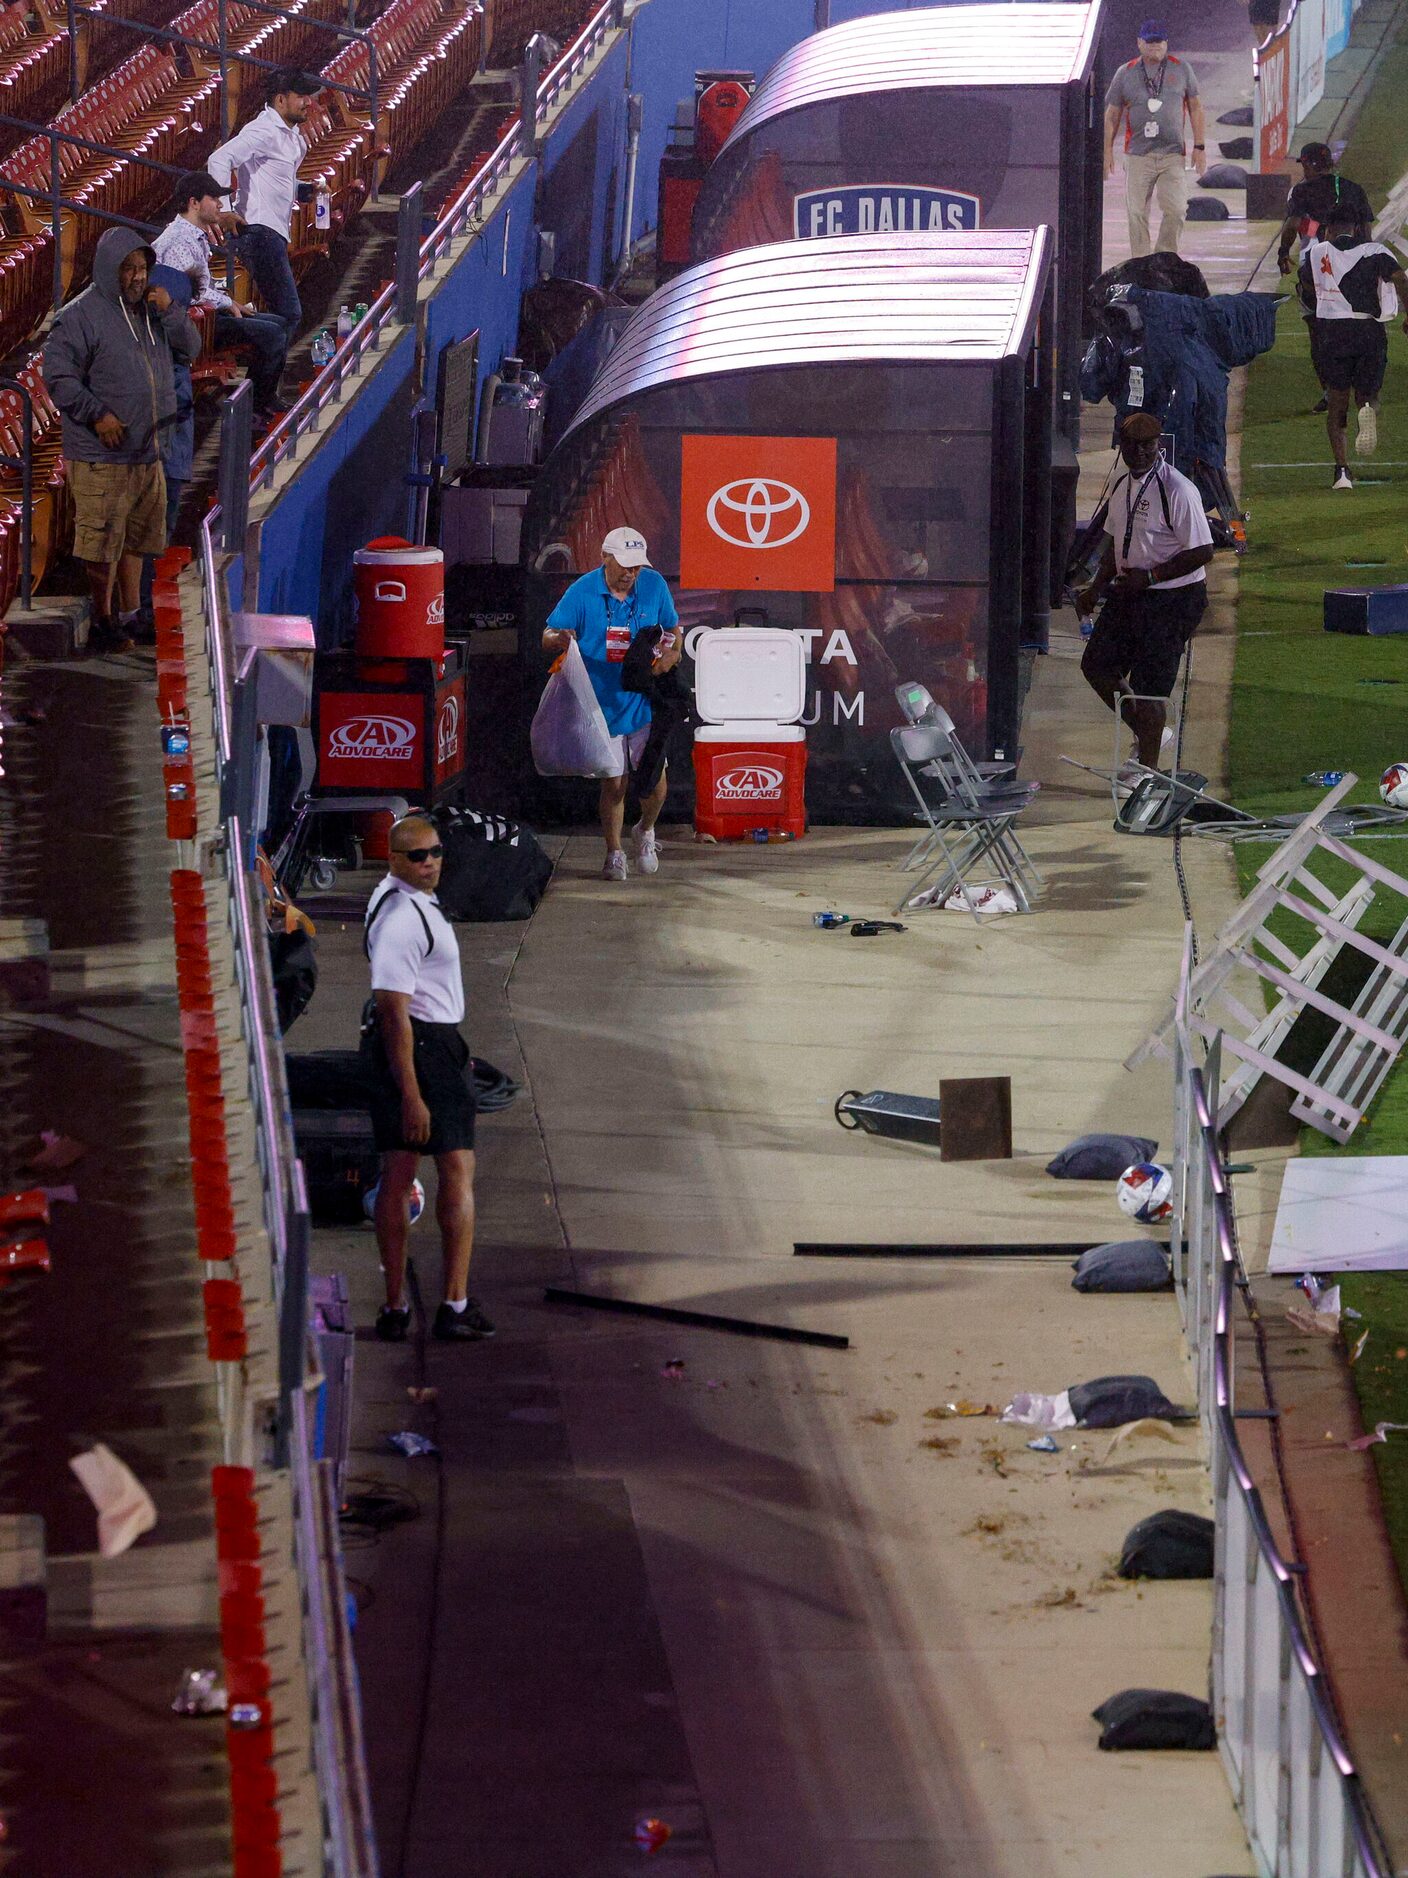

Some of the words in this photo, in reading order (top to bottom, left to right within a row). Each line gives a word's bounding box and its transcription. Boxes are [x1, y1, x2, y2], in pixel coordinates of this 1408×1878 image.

[811, 200, 842, 237] FC
[858, 197, 963, 232] DALLAS
[329, 745, 412, 759] ADVOCARE
[716, 788, 781, 799] ADVOCARE
